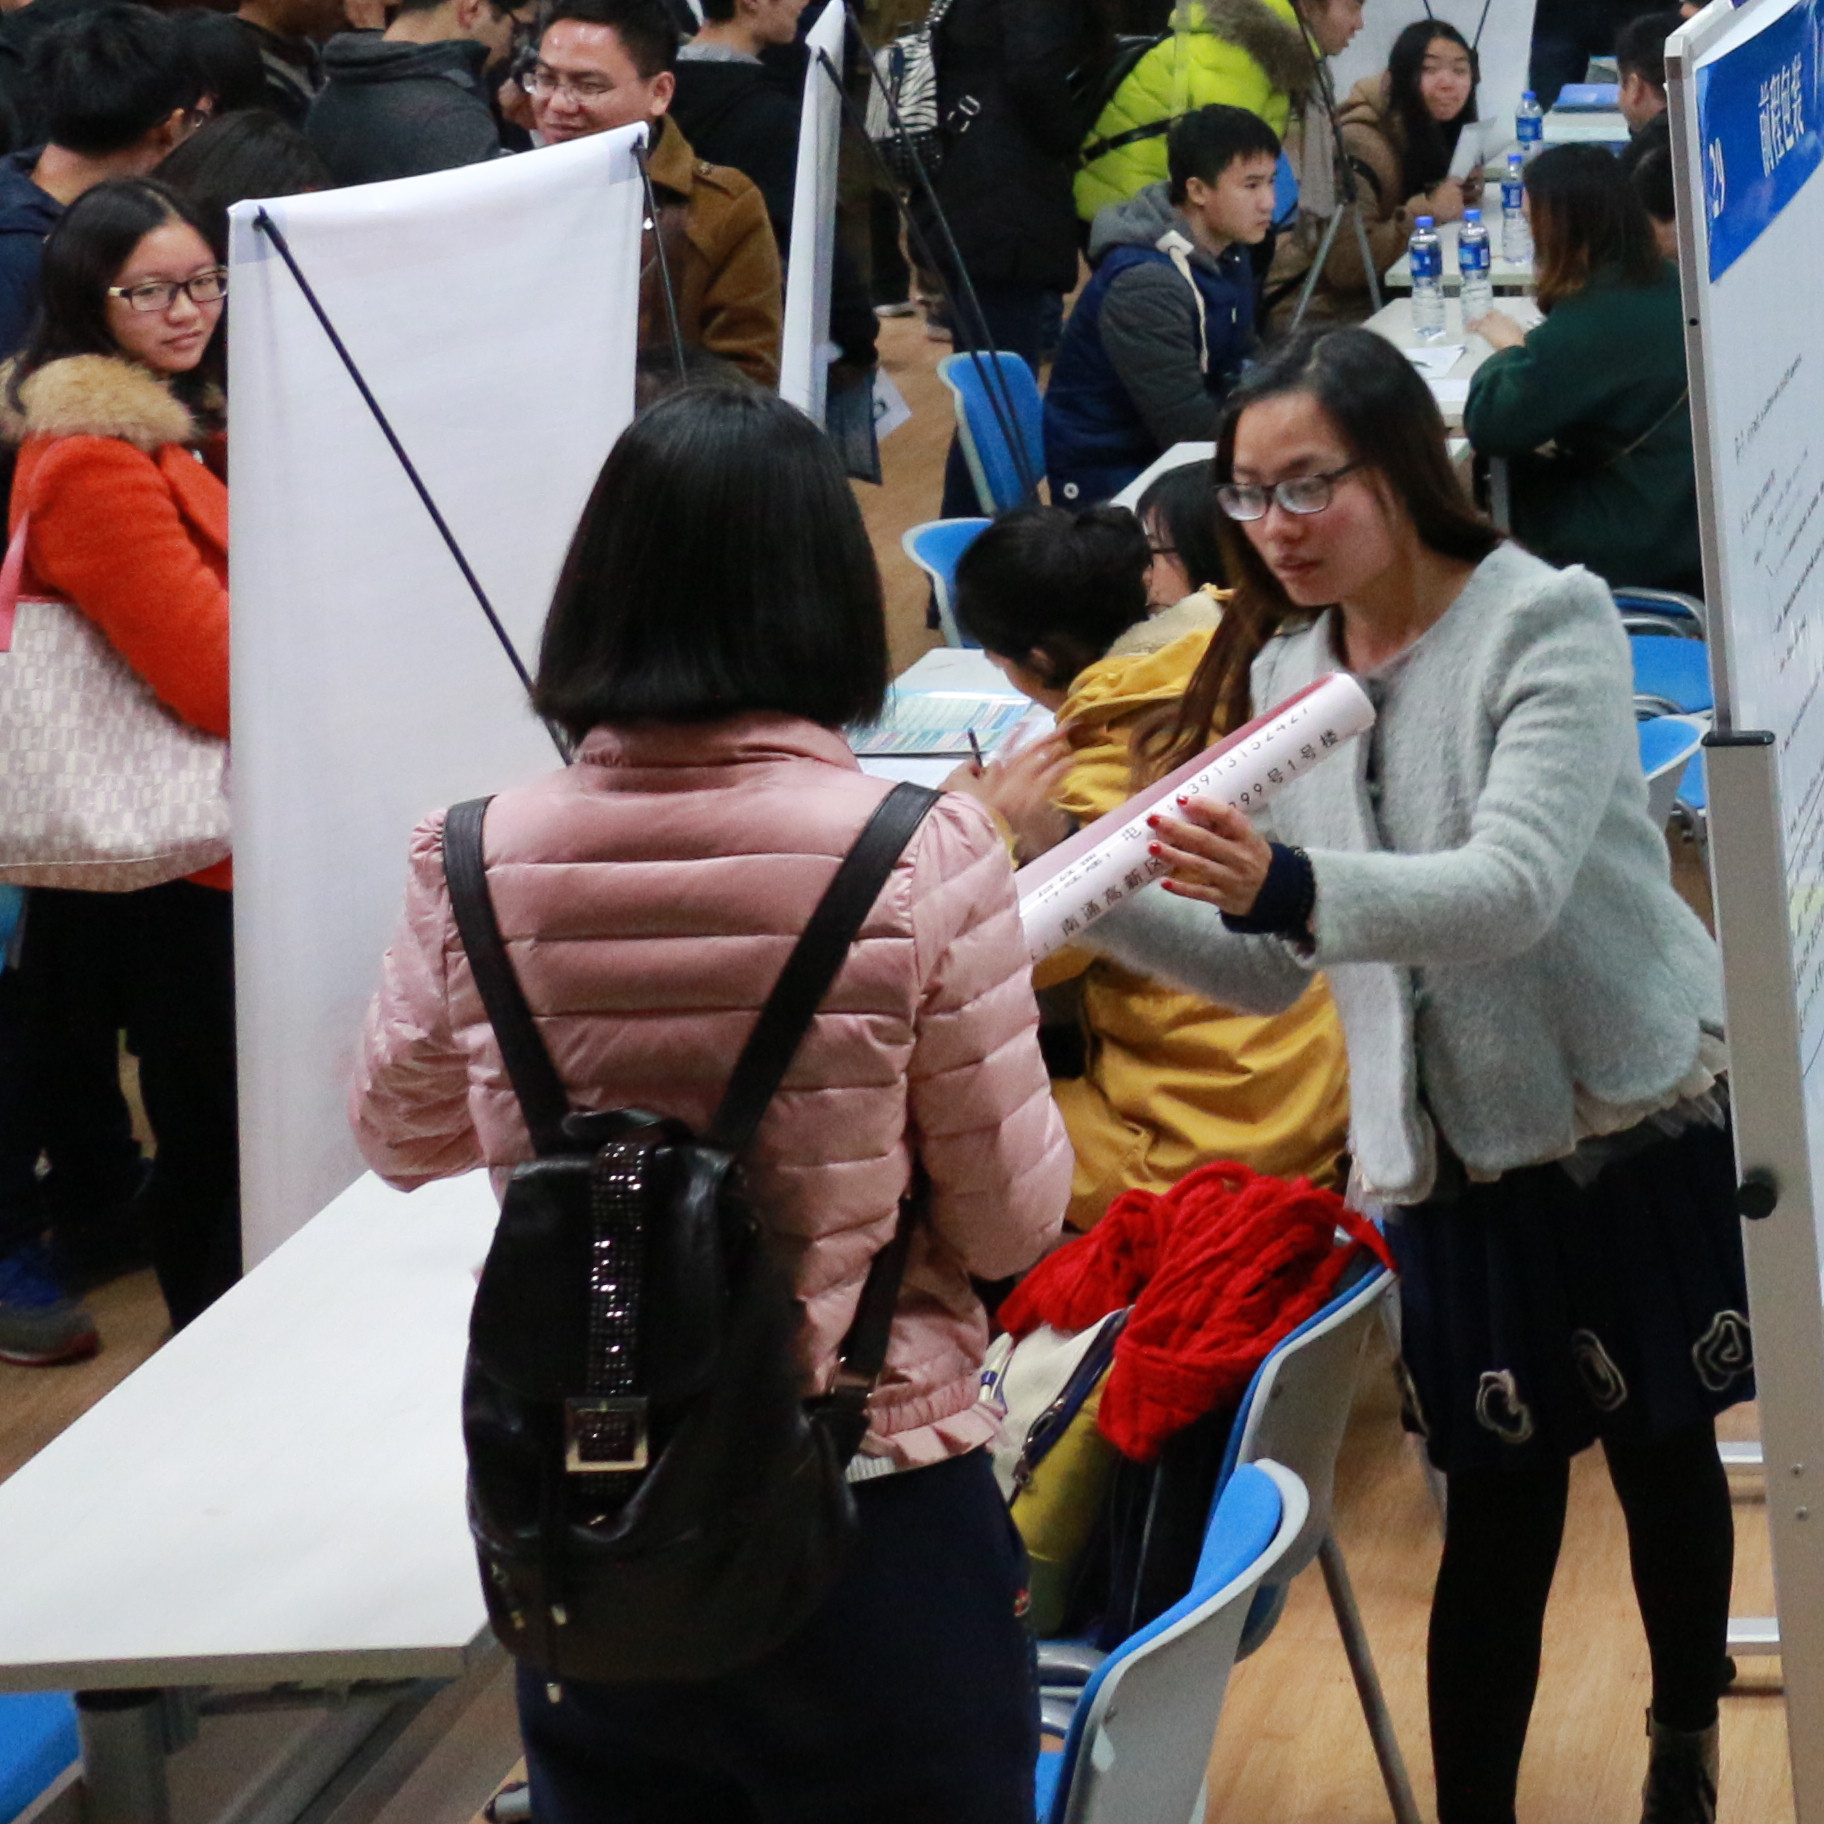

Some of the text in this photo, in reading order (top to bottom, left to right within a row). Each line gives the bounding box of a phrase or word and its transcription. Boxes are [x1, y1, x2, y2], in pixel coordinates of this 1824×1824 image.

[1759, 52, 1805, 177] 前程包装
[1709, 137, 1725, 218] 29
